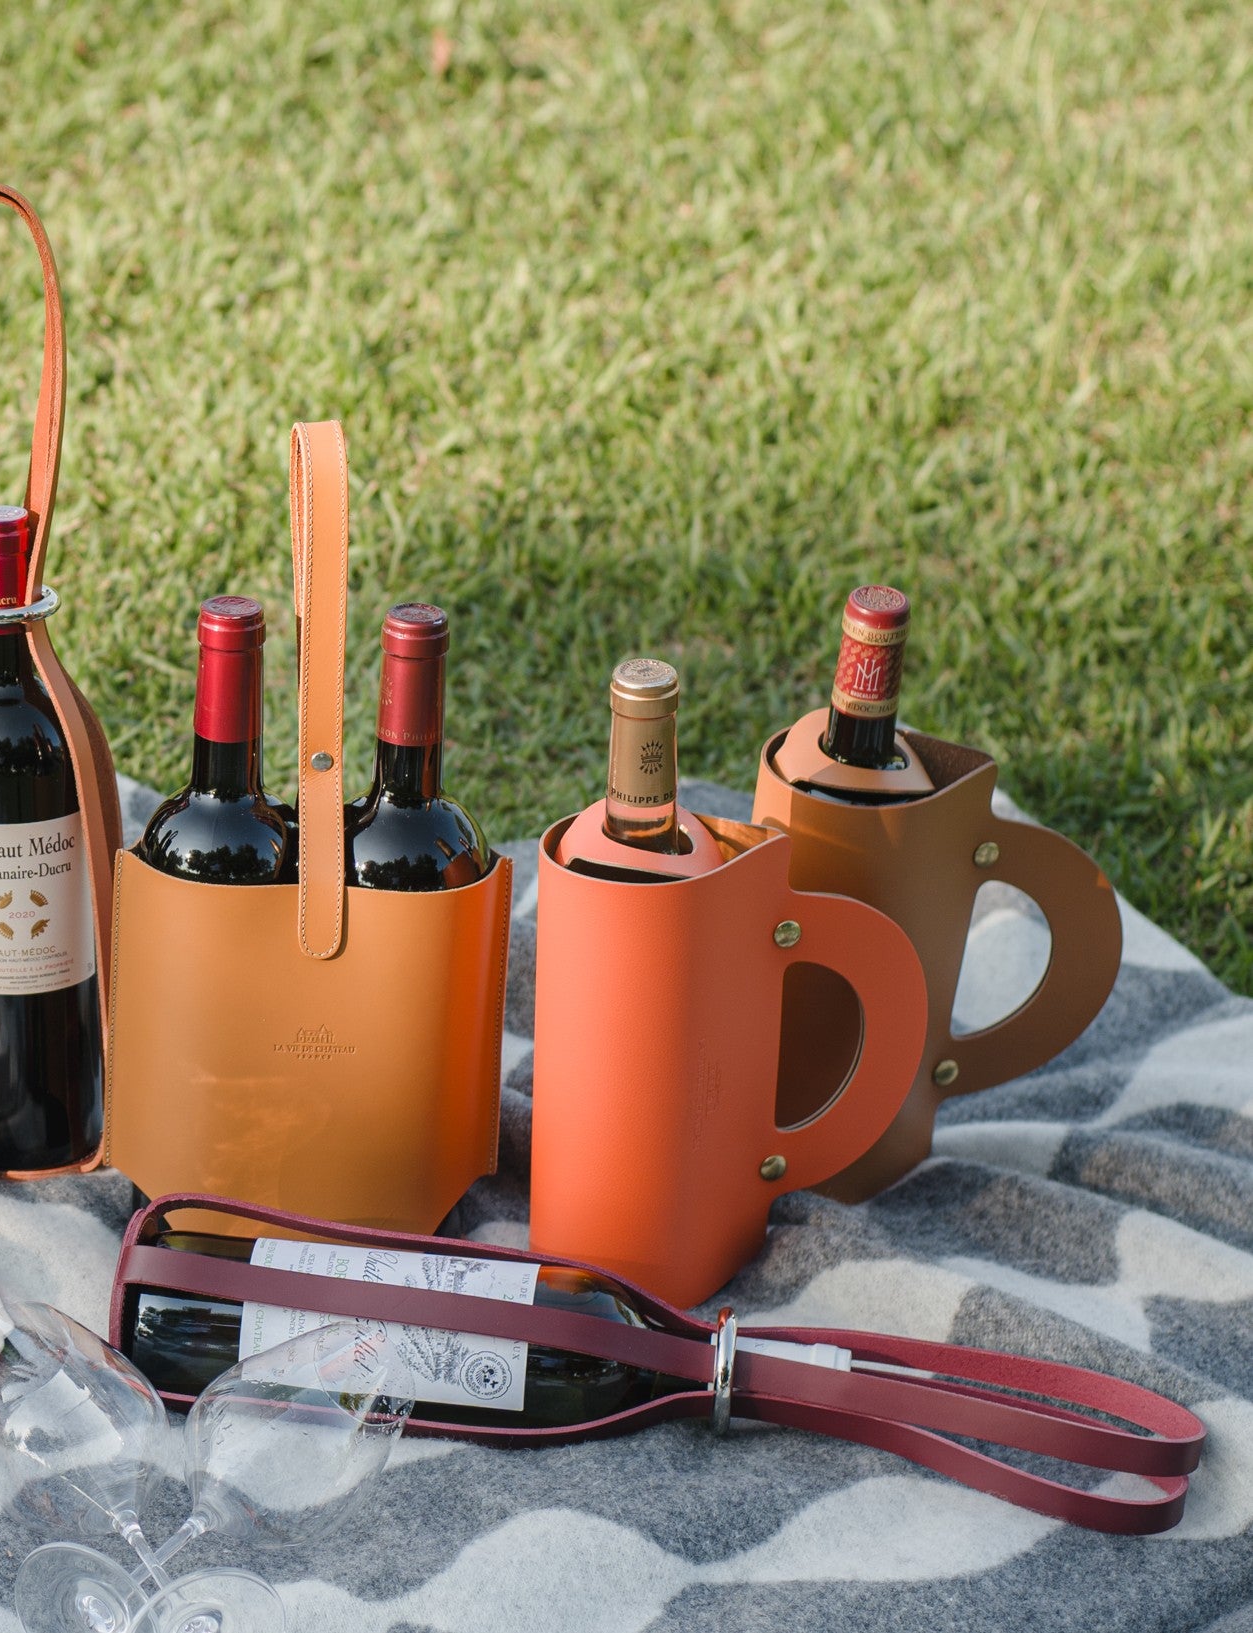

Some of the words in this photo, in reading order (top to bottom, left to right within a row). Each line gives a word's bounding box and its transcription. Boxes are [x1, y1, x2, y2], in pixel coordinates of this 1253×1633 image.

[610, 787, 659, 804] PHILIPPE
[28, 832, 75, 857] Médoc
[9, 910, 36, 919] 2020
